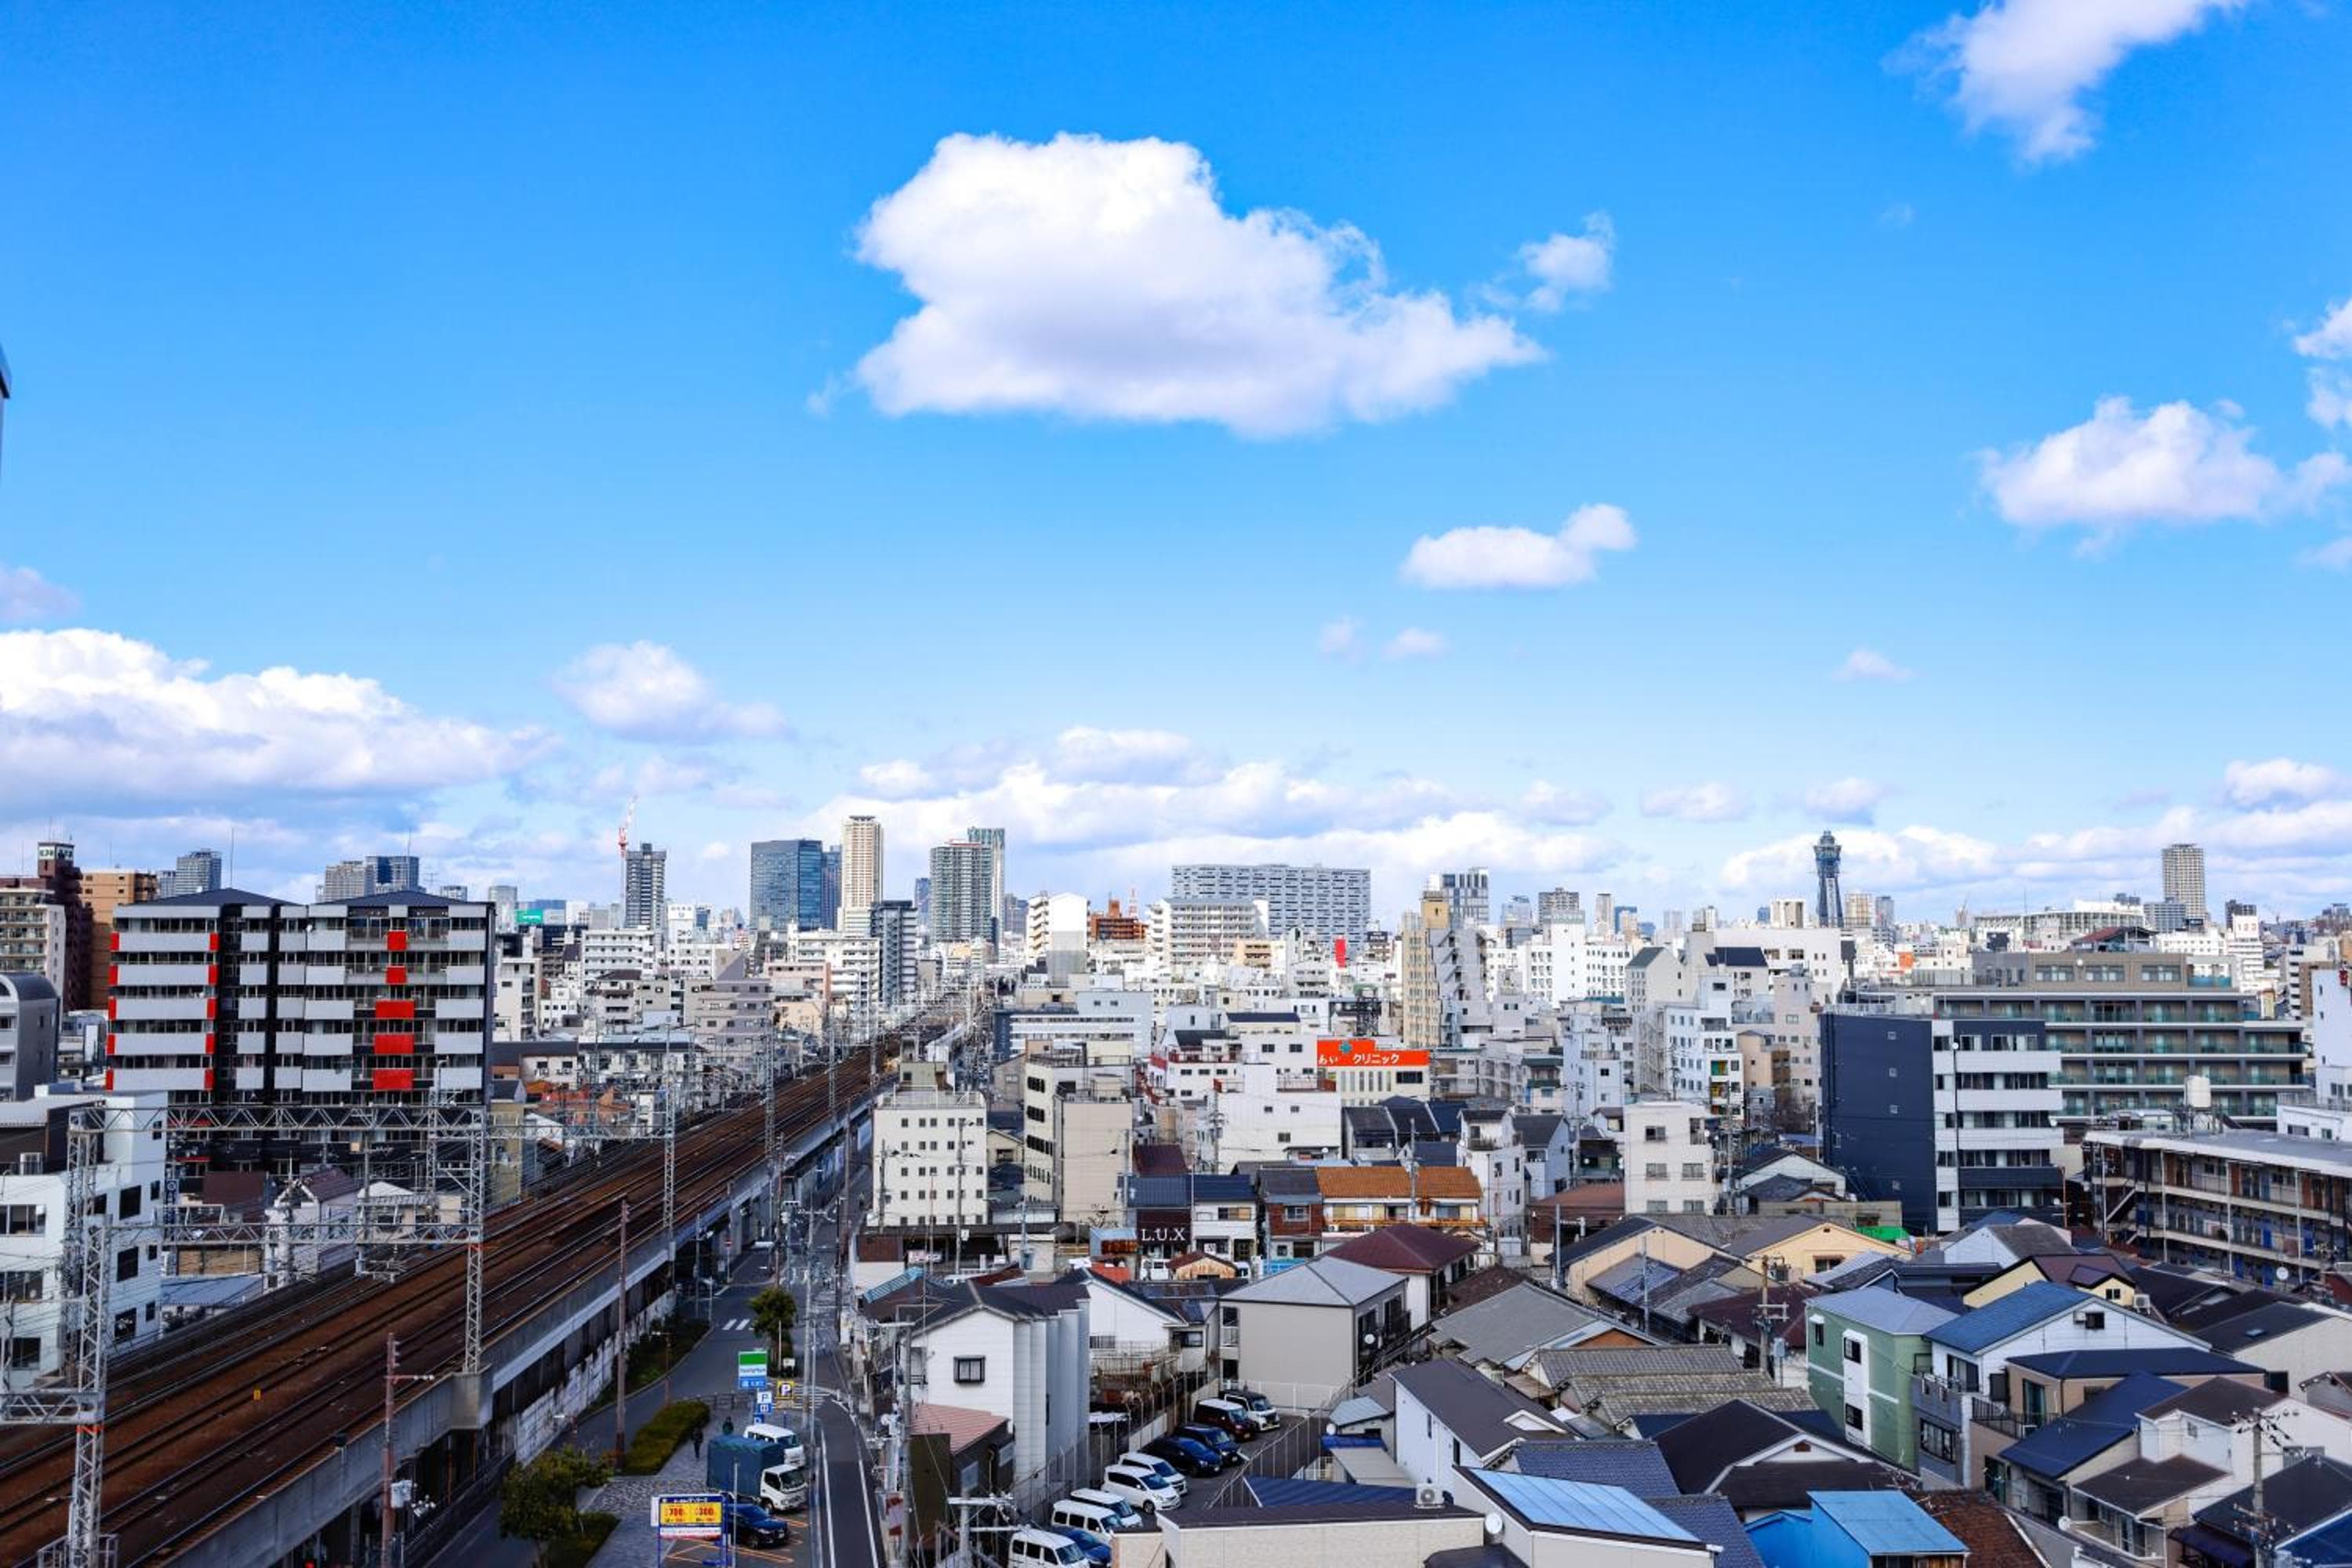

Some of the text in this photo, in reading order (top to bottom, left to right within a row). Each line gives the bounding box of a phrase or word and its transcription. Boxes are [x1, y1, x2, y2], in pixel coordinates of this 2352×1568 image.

[1352, 1054, 1399, 1064] クリニック
[1142, 1228, 1186, 1241] L.U.X
[781, 1384, 791, 1396] P
[761, 1393, 769, 1403] P
